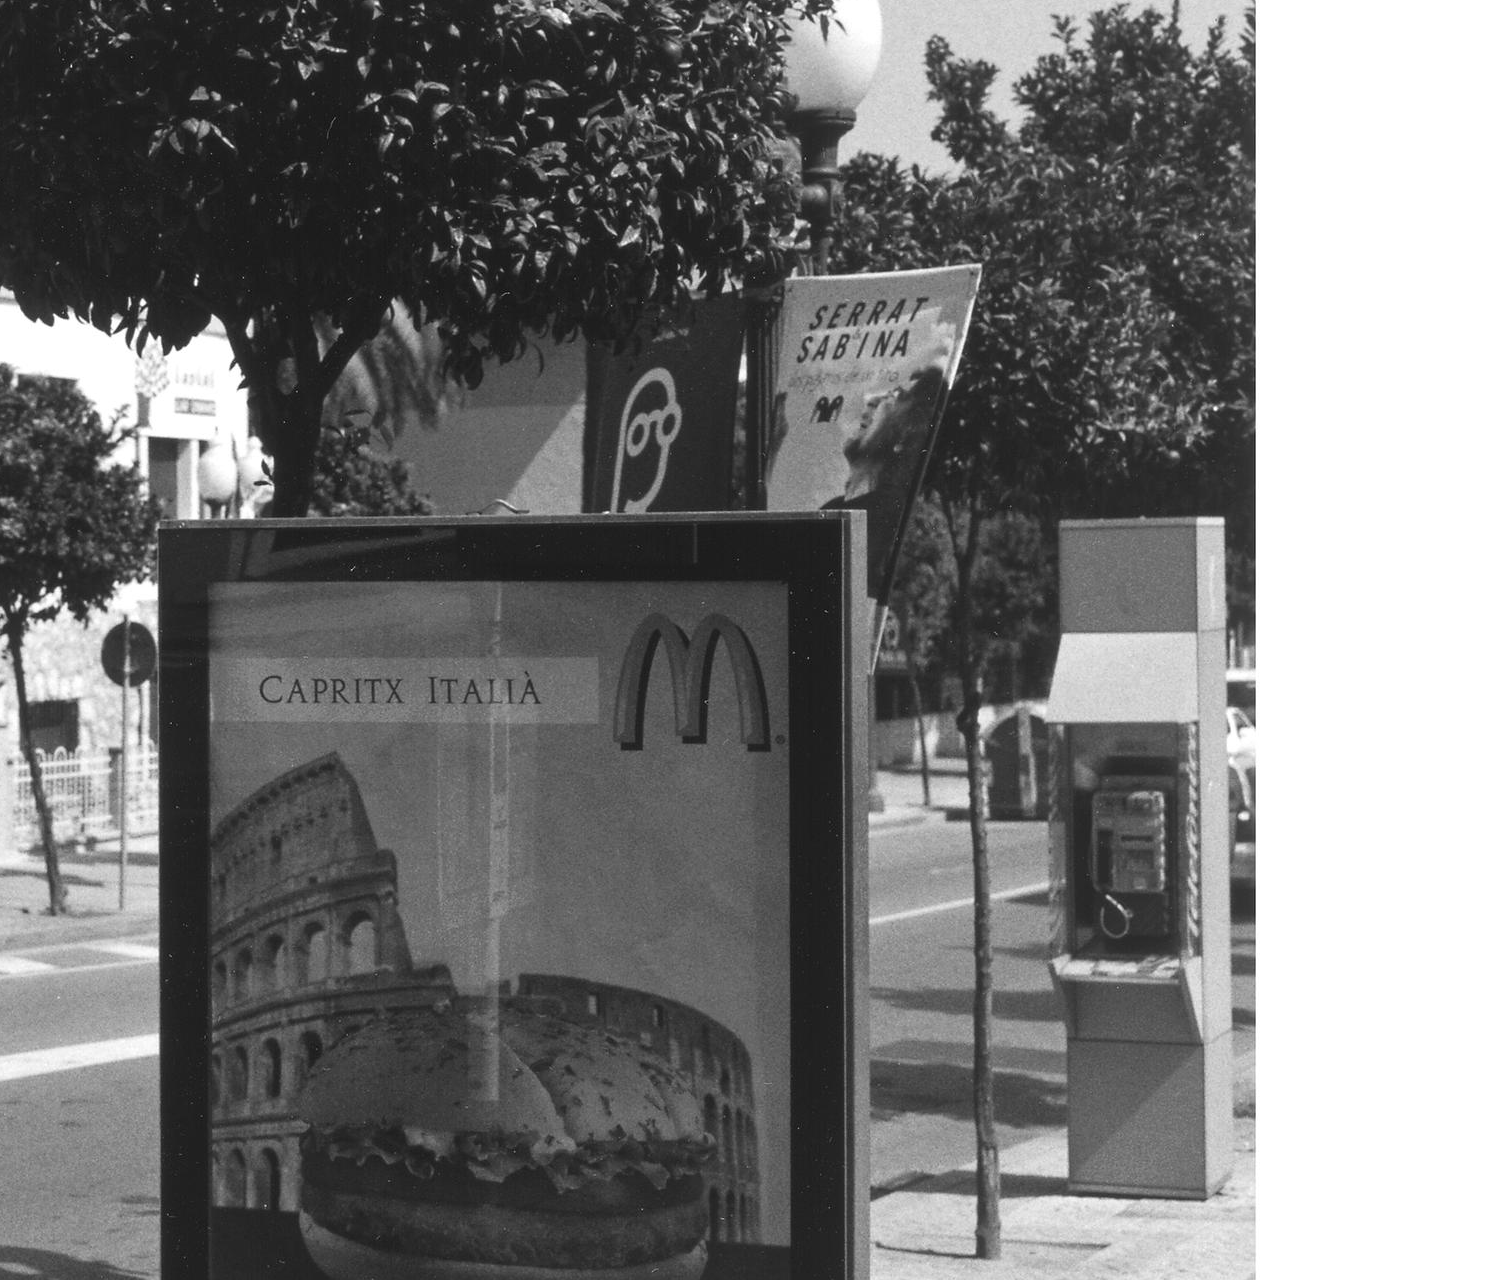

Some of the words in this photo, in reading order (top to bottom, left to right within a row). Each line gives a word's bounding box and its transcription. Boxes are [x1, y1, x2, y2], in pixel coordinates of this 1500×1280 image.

[809, 297, 929, 330] SERRAT
[797, 329, 911, 363] SABINA
[259, 674, 405, 706] CAPRITX
[428, 671, 542, 706] ITALIÀ
